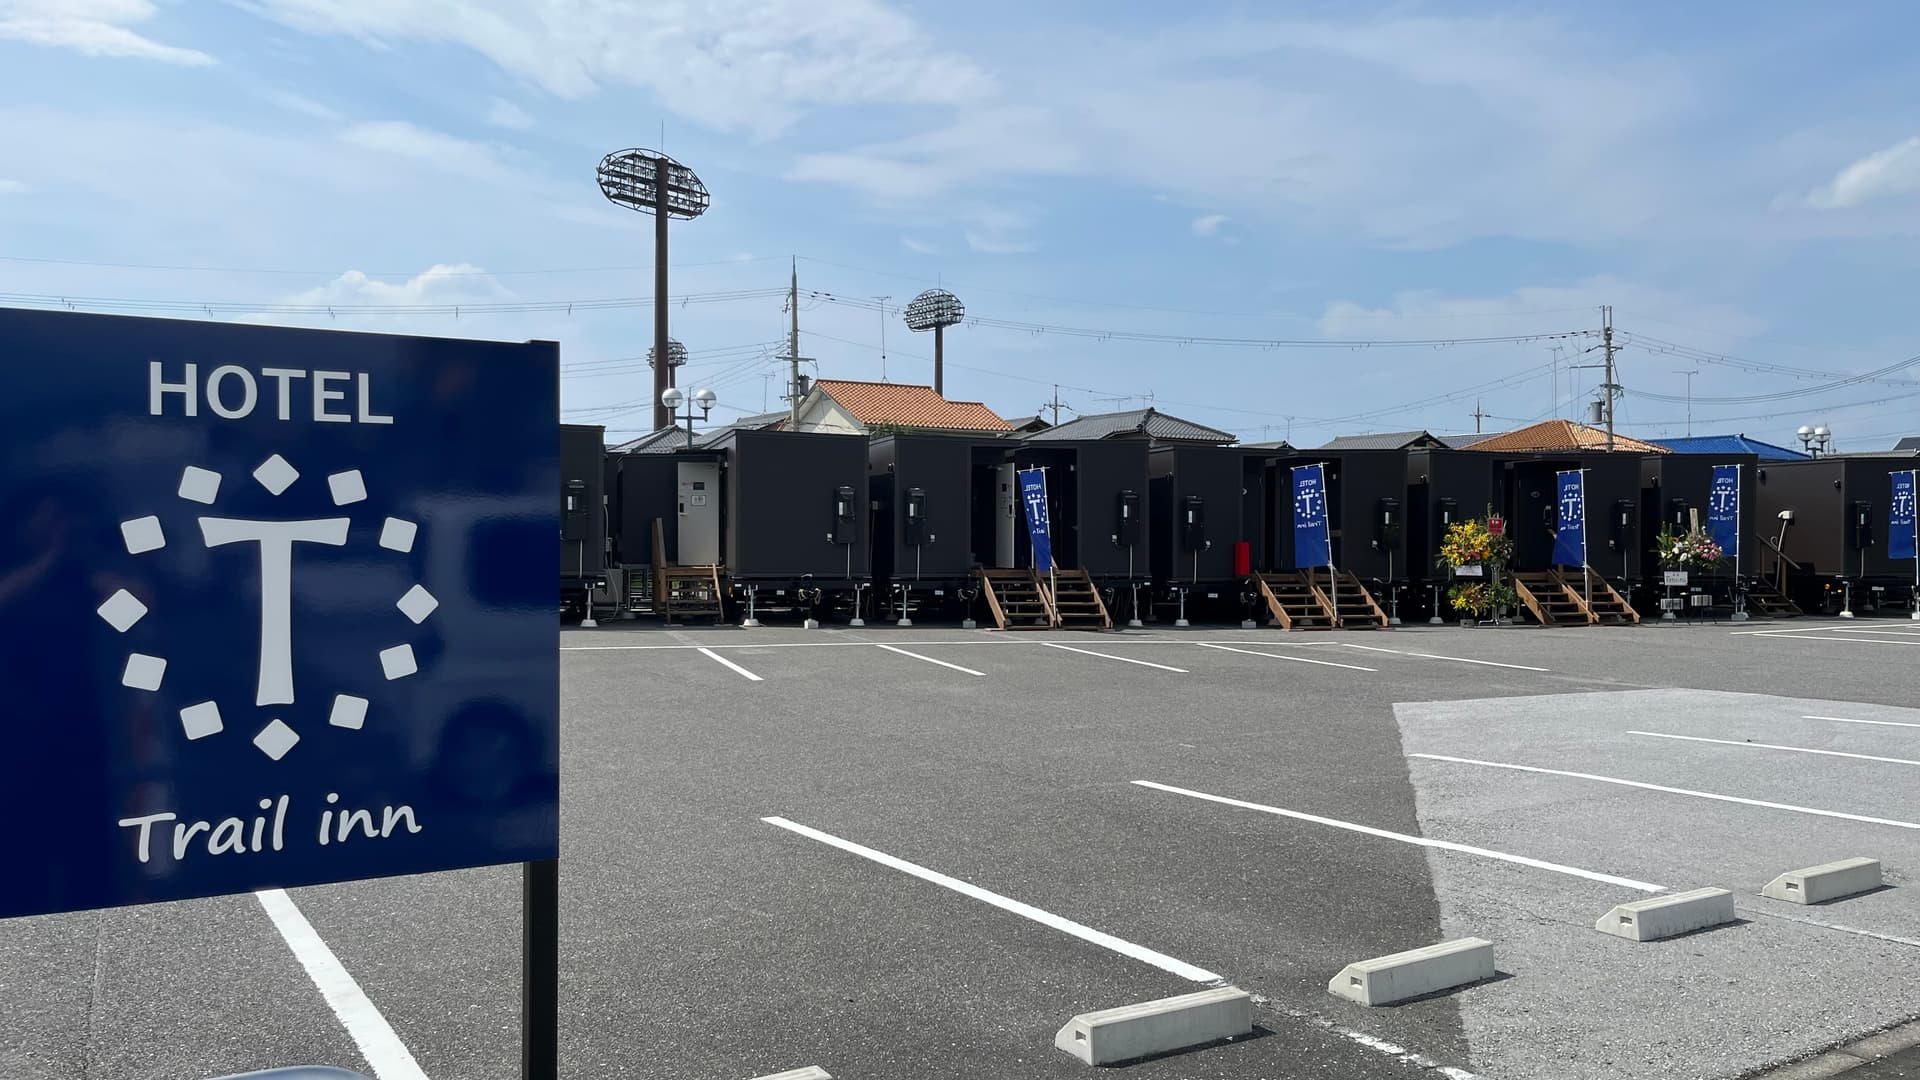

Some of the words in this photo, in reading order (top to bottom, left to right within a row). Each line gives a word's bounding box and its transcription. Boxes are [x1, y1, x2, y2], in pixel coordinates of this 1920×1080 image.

[150, 361, 394, 424] HOTEL
[198, 517, 350, 706] T
[118, 794, 290, 863] Trail
[319, 792, 422, 846] inn
